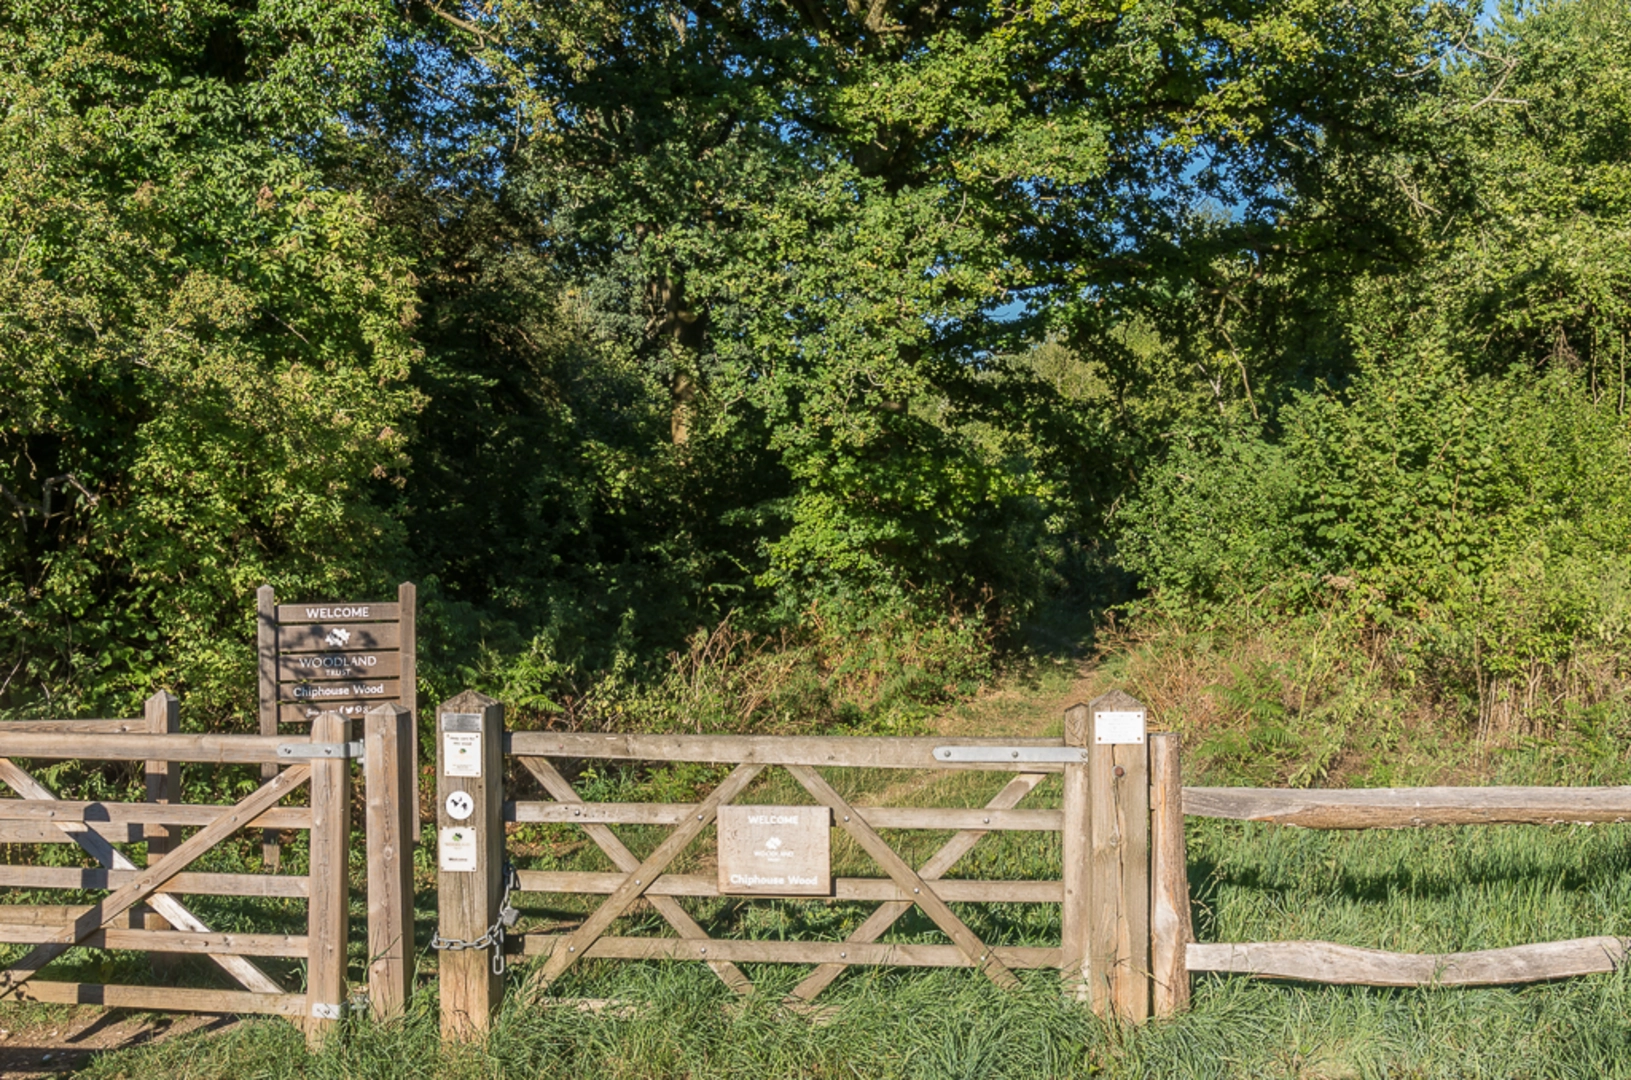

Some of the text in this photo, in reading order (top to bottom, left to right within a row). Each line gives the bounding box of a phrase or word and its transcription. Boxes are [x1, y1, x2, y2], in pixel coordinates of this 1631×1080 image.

[306, 607, 369, 618] WELCOME
[299, 656, 376, 668] WOODLAND
[325, 669, 351, 677] TRUST
[293, 683, 384, 698] Chiphouse Wood
[748, 815, 799, 825] WELCOME
[730, 874, 818, 886] Chiphouse Wood
